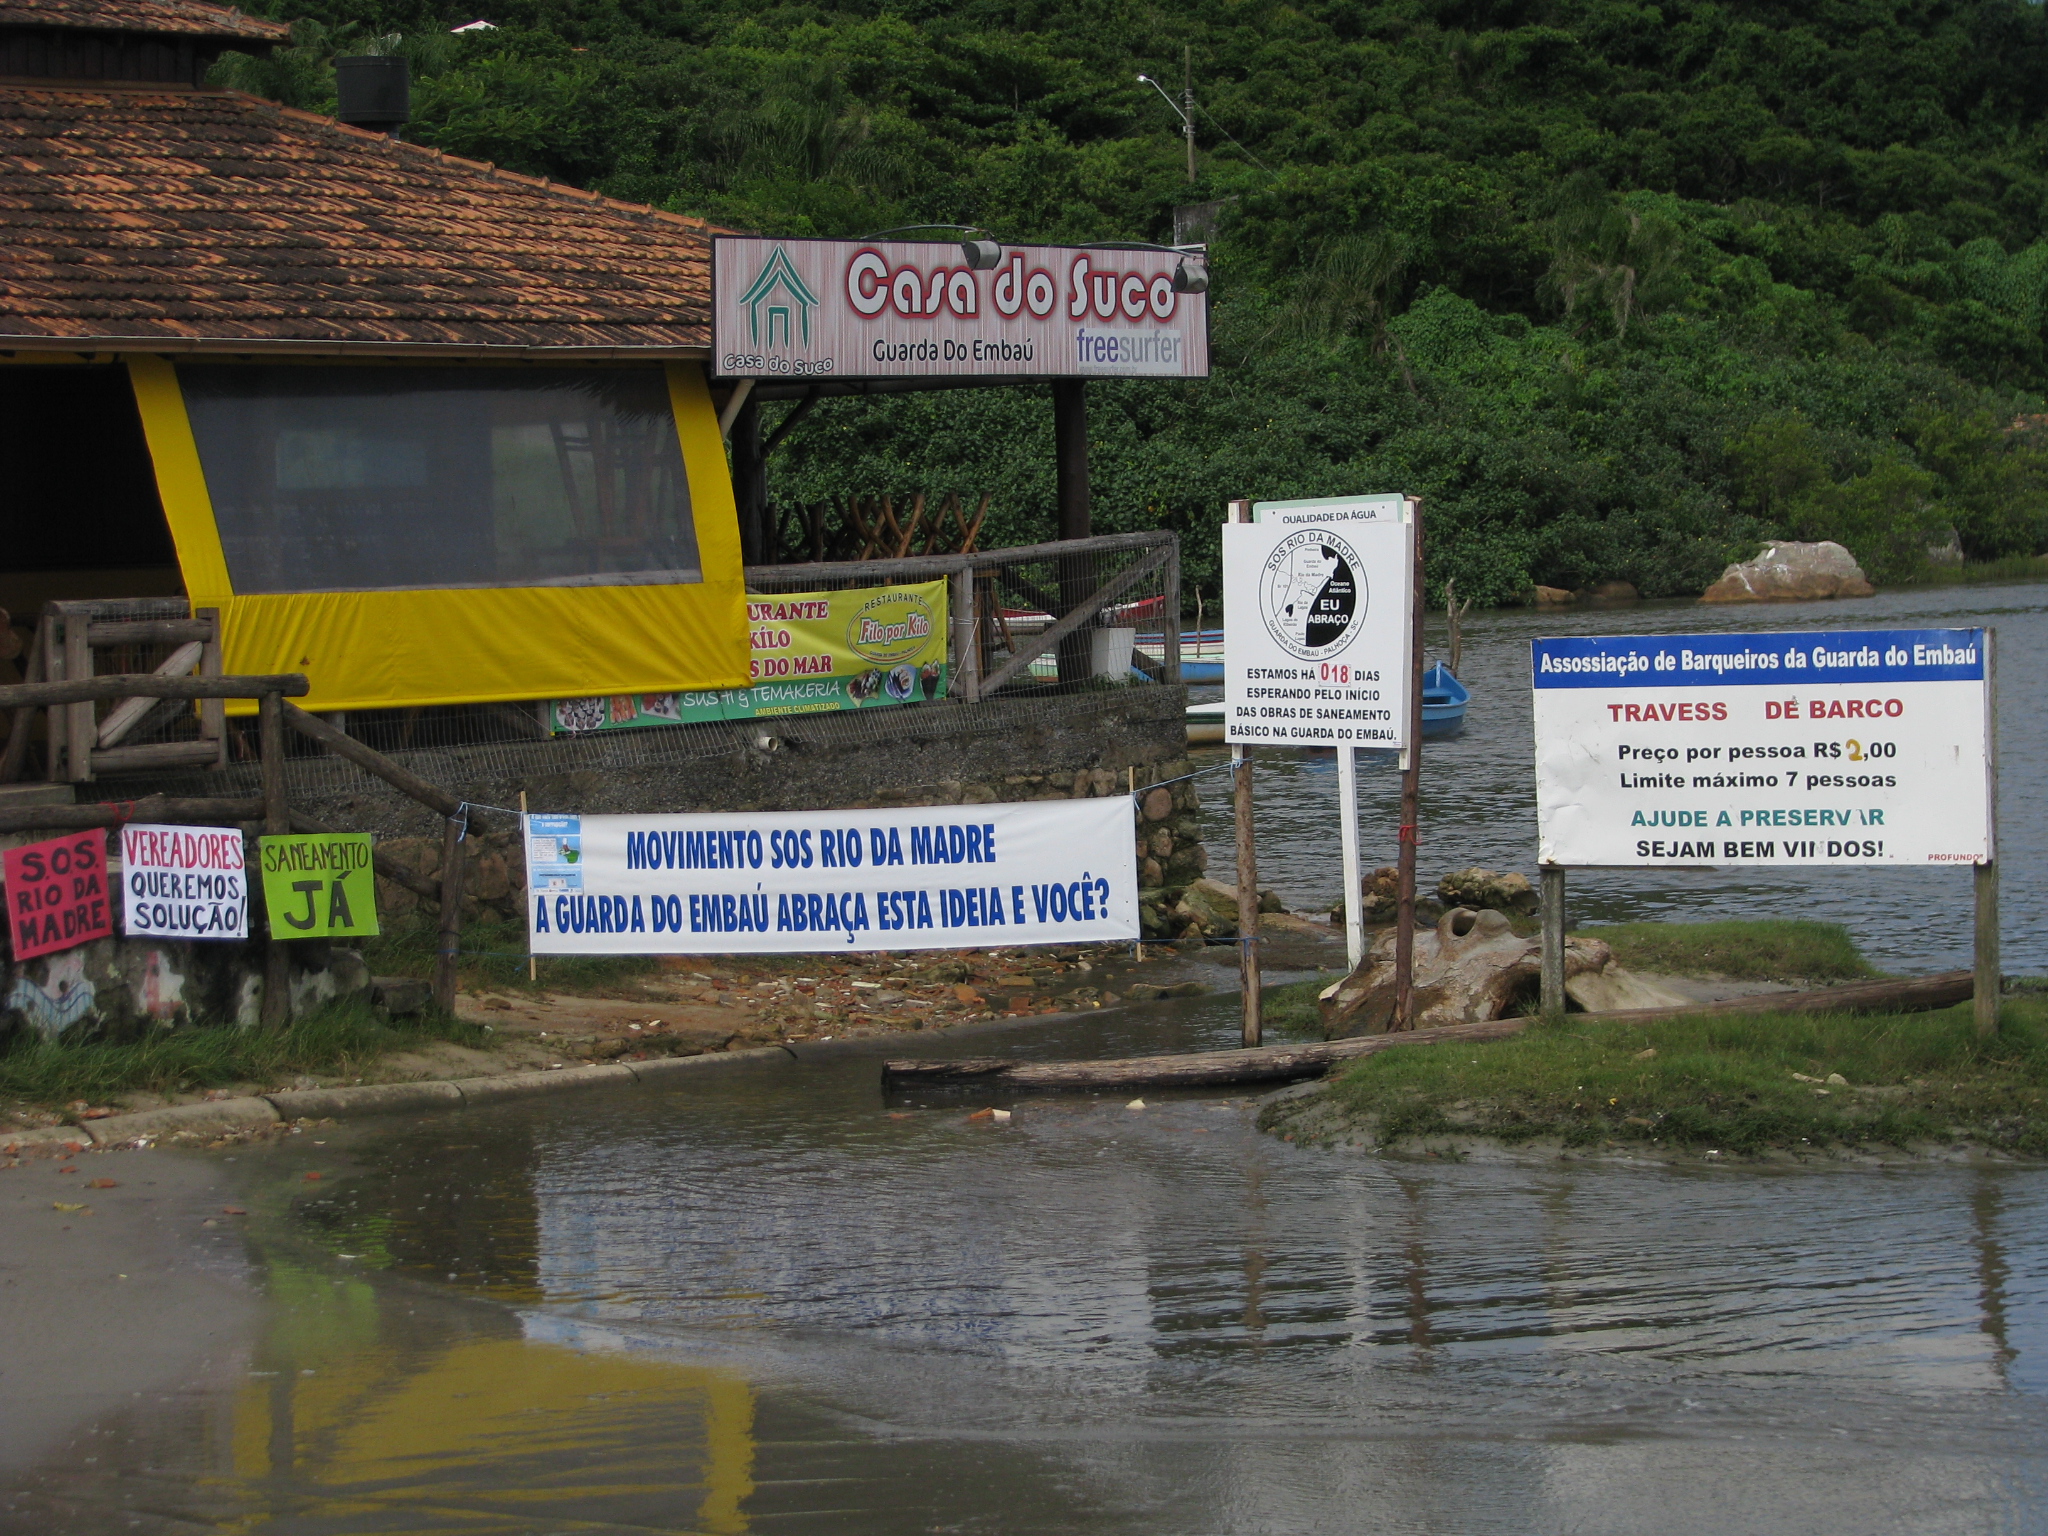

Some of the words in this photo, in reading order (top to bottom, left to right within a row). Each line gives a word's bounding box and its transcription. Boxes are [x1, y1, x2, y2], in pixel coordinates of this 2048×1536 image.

[846, 247, 979, 320] Casa
[993, 252, 1057, 320] do
[1068, 253, 1178, 322] Suco
[873, 339, 938, 361] Guarda
[944, 340, 967, 361] Do
[973, 338, 1033, 361] Embaú
[1077, 328, 1181, 363] freesurfer
[723, 353, 764, 370] Casa
[768, 355, 791, 373] do
[794, 358, 833, 375] Suco
[1282, 512, 1334, 524] QUALIDADE
[1336, 511, 1349, 521] DA
[1351, 509, 1377, 520] ÁGUA
[1268, 547, 1287, 571] SOS
[1287, 534, 1305, 550] RIO
[1309, 532, 1324, 542] DA
[1327, 535, 1360, 572] MADRE
[864, 592, 923, 612] RESTAURANTE
[1320, 599, 1340, 611] EU
[858, 618, 884, 644] Filo
[884, 623, 905, 646] por
[906, 611, 929, 638] Kilo
[1308, 614, 1349, 626] ABRAÇO
[1268, 619, 1288, 646] GUARDA
[1289, 643, 1298, 652] DO
[1298, 648, 1319, 657] EMBAÚ
[1324, 633, 1351, 655] PALHOÇA
[1351, 619, 1359, 631] SC
[764, 658, 790, 677] DO
[793, 655, 832, 675] MAR
[1540, 651, 1649, 677] Assossiação
[1654, 650, 1676, 671] de
[1681, 648, 1779, 675] Barqueiros
[1784, 648, 1807, 668] da
[1812, 646, 1879, 668] Guarda
[1884, 645, 1908, 666] do
[1913, 642, 1976, 666] Embaú
[1247, 668, 1298, 680] ESTAMOS
[1301, 667, 1315, 680] HÁ
[1320, 662, 1349, 684] 018
[1354, 670, 1380, 682] DIAS
[751, 681, 840, 702] TEMAKERIA
[1247, 687, 1311, 700] ESPERANDO
[1314, 689, 1342, 700] PELO
[1345, 687, 1380, 701] INÍCIO
[755, 705, 792, 716] AMBIENTE
[794, 702, 841, 713] CLIMATIZADO
[1236, 706, 1257, 717] DAS
[1260, 707, 1296, 719] OBRAS
[1299, 708, 1313, 719] DE
[1316, 708, 1391, 721] SANEAMENTO
[1809, 698, 1904, 719] BARCO
[1230, 723, 1269, 737] BÁSICO
[1273, 726, 1287, 737] NA
[1291, 727, 1334, 739] GUARDA
[1337, 728, 1352, 740] DO
[1356, 727, 1397, 741] EMBAÚ.
[1618, 744, 1679, 763] Preço
[1686, 745, 1722, 763] por
[1728, 744, 1806, 762] pessoa
[1620, 772, 1685, 788] Limite
[1692, 771, 1778, 788] máximo
[1785, 772, 1798, 787] 7
[1807, 773, 1897, 790] pessoas
[1631, 810, 1708, 827] AJUDE
[1716, 810, 1732, 827] A
[124, 828, 245, 870] VEREADORES
[264, 842, 369, 872] SANEAMENTO
[627, 830, 763, 870] MOVIMENTO
[770, 829, 813, 869] SOS
[820, 828, 863, 868] RIO
[870, 827, 904, 866] DA
[910, 823, 996, 865] MADRE
[1636, 840, 1715, 858] SEJAM
[1724, 841, 1774, 858] BEM
[17, 884, 62, 914] RIO
[73, 874, 101, 900] DA
[131, 871, 240, 900] QUEREMOS
[283, 871, 354, 930] JÁ
[536, 894, 550, 933] A
[555, 894, 645, 933] GUARDA
[652, 894, 682, 933] DO
[689, 882, 770, 932] EMBAÚ
[777, 892, 870, 944] ABRAÇA
[877, 890, 934, 930] ESTA
[940, 887, 1006, 928] IDEIA
[1012, 885, 1026, 925] E
[1031, 871, 1110, 923] VOCÊ?
[19, 899, 105, 950] MADRE
[134, 896, 247, 937] SOLUÇÃO!
